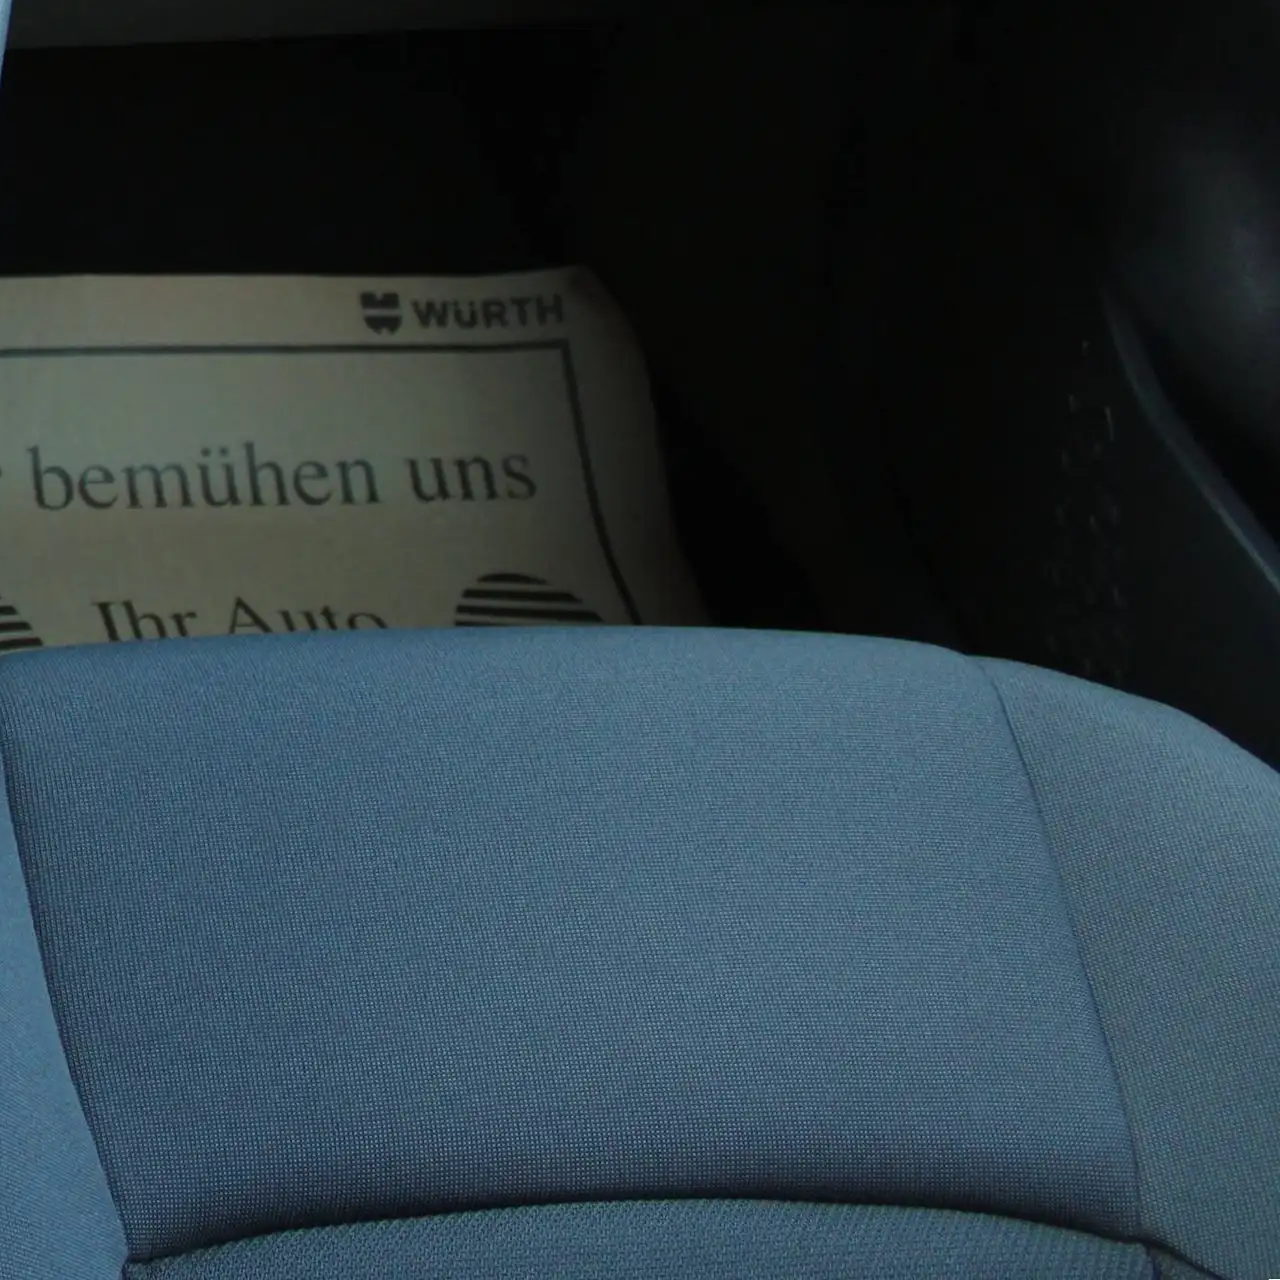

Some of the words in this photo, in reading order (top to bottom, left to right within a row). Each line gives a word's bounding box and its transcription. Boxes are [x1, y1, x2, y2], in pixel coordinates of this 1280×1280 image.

[27, 441, 381, 512] bemühen
[405, 451, 539, 504] uns
[93, 599, 198, 643] Ihr
